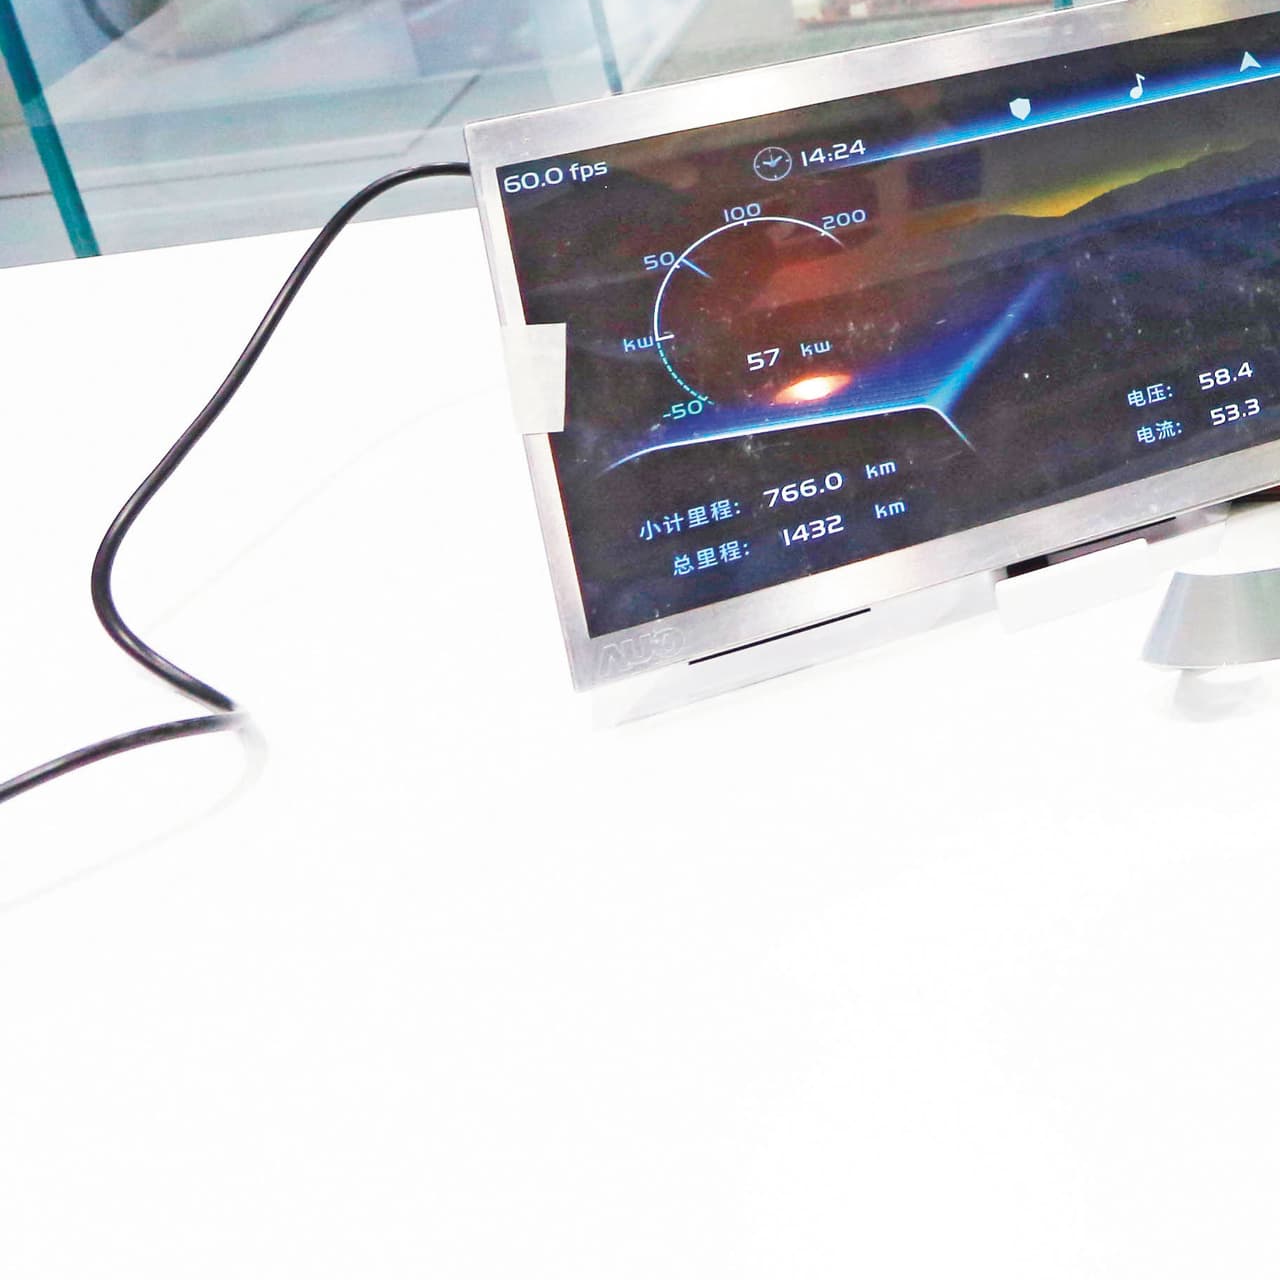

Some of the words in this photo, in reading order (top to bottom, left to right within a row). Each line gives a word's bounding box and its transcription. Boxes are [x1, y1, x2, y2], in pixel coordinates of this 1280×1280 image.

[799, 138, 867, 167] 14:24
[503, 167, 564, 194] 60.0
[568, 160, 609, 183] fps
[723, 202, 762, 222] 100
[821, 207, 867, 231] 200
[643, 250, 677, 271] 50
[746, 347, 782, 372] 57
[1198, 362, 1253, 390] 58.4
[662, 399, 705, 420] -50
[1209, 397, 1261, 427] 53.3
[761, 471, 844, 509] 766.0
[864, 459, 897, 480] km
[780, 514, 845, 548] 1432
[873, 498, 906, 520] km
